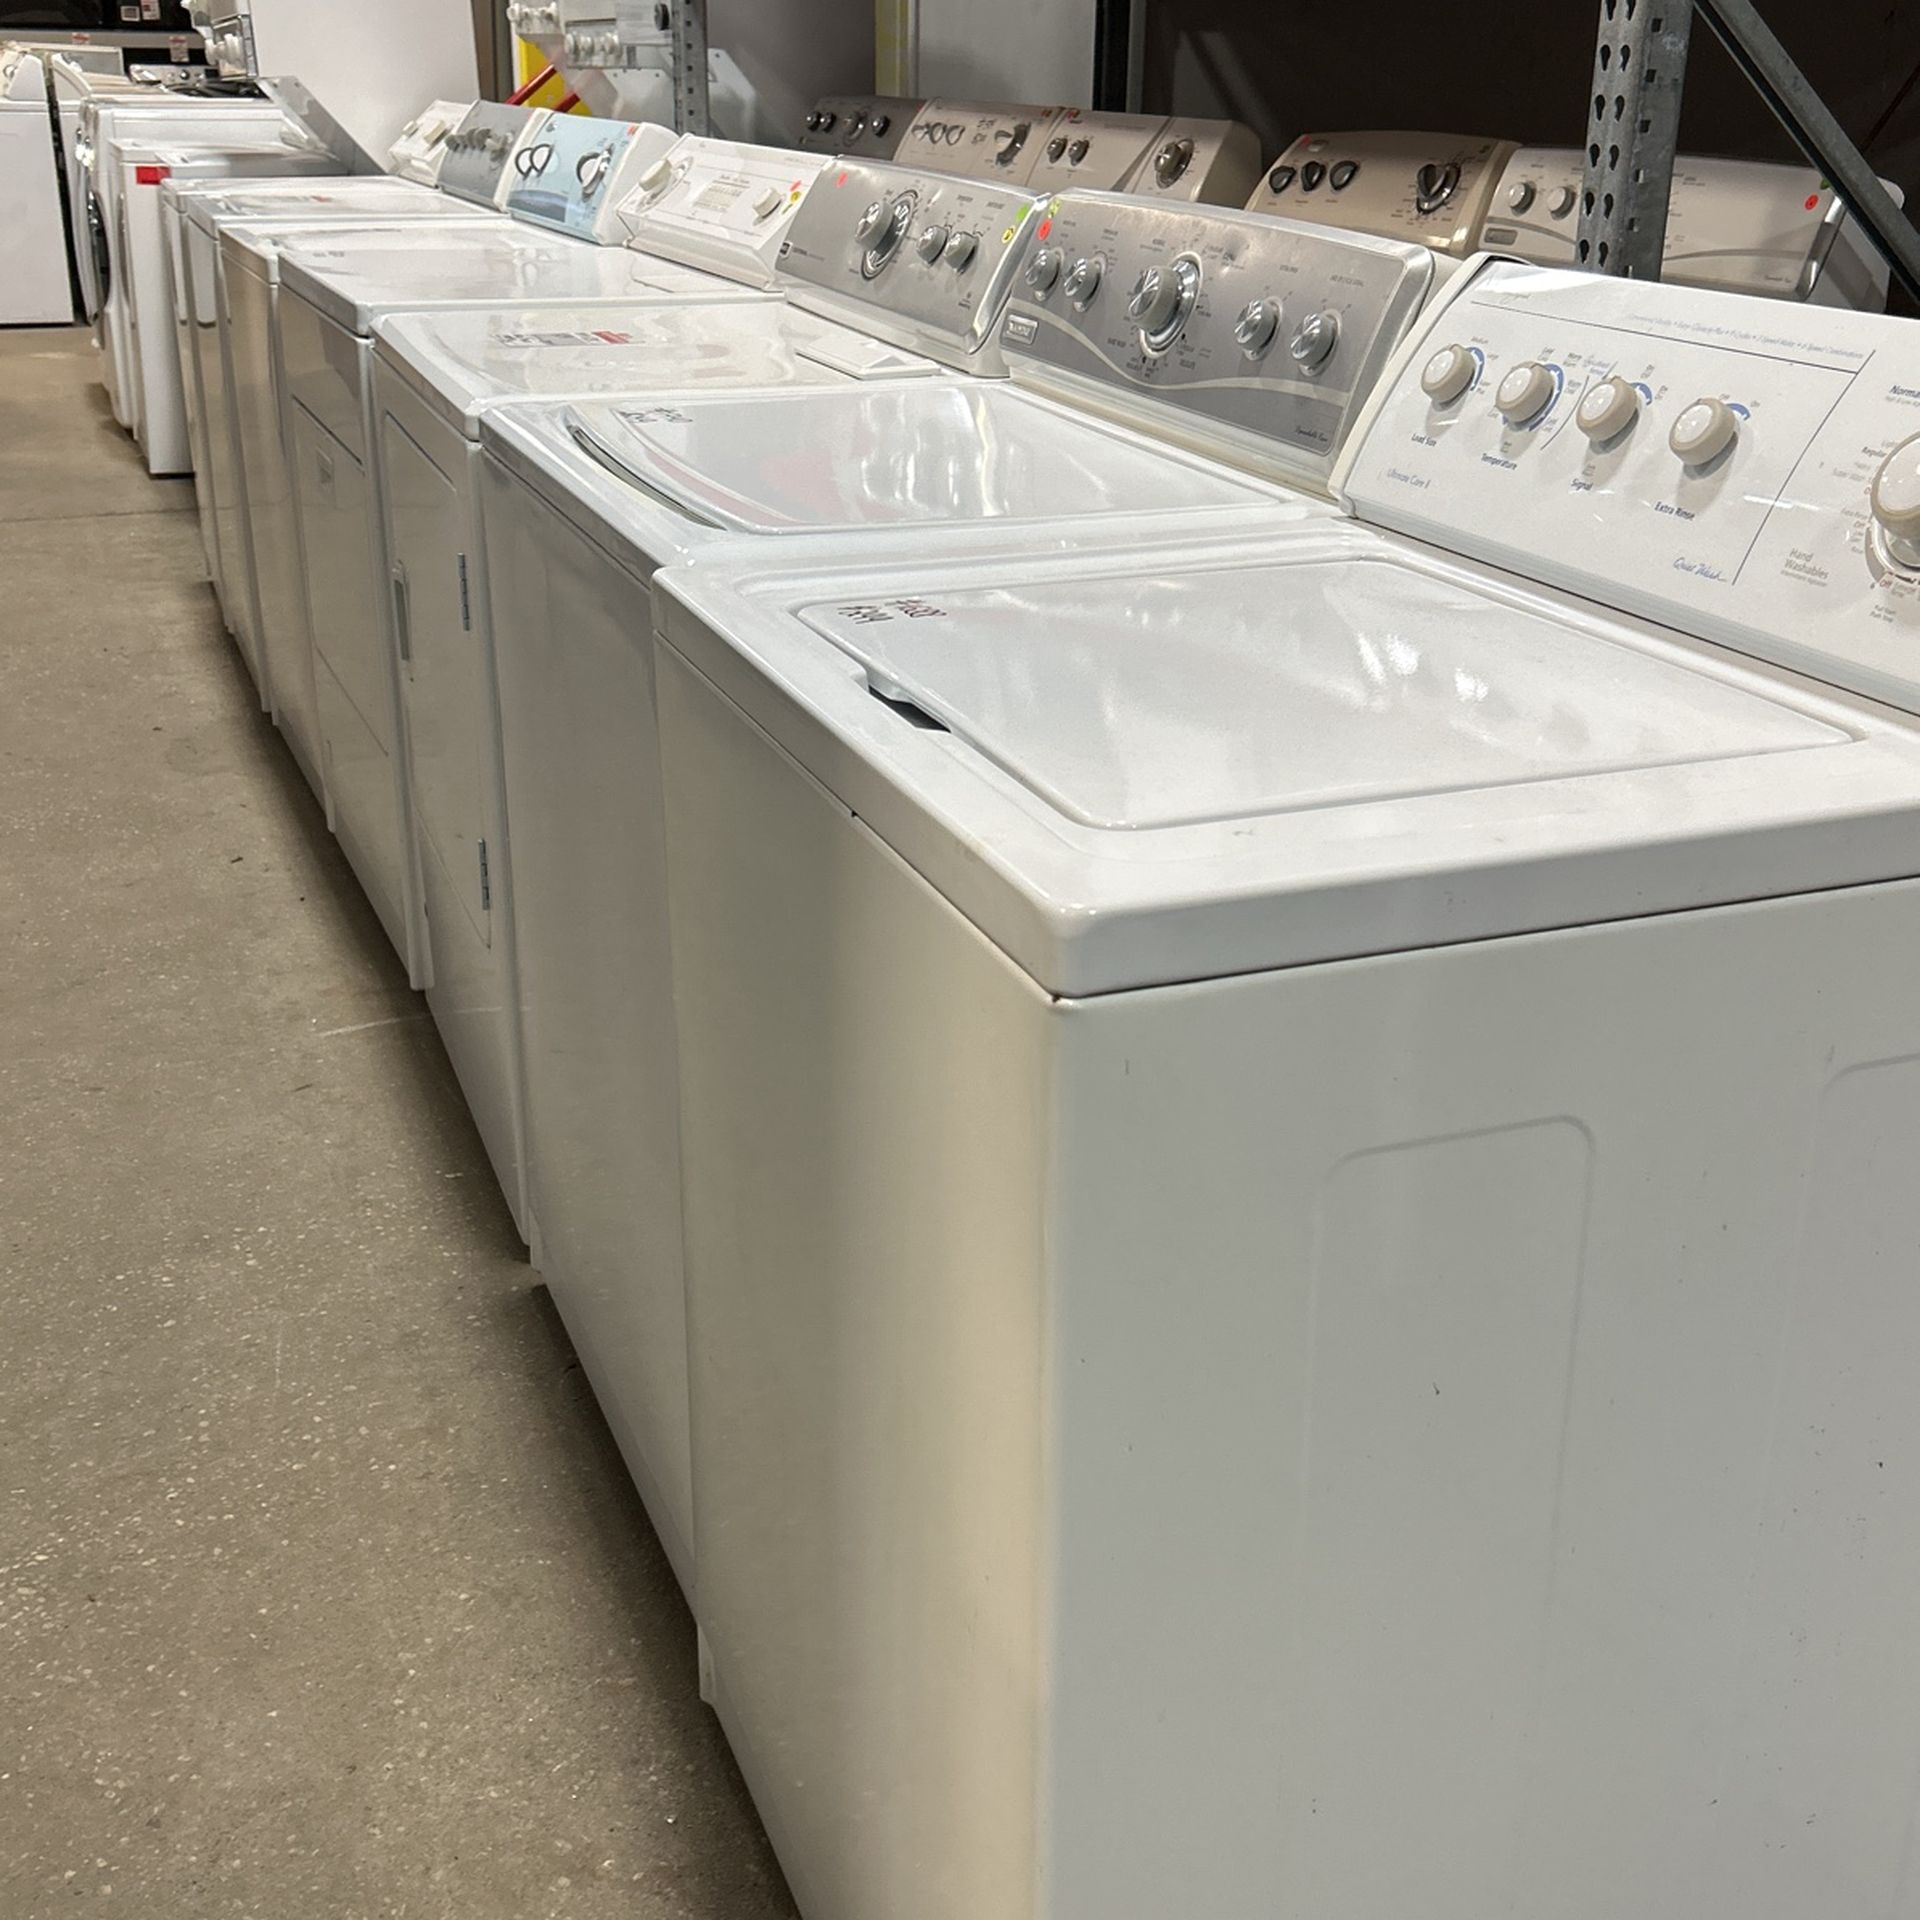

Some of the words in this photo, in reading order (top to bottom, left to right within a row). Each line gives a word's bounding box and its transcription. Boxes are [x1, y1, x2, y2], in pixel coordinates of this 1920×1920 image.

[1411, 432, 1427, 445] Load
[1424, 435, 1437, 447] Size
[1481, 452, 1518, 471] Temperature
[1571, 477, 1594, 492] Signal
[1654, 500, 1675, 515] Extra
[1675, 506, 1696, 521] Rinse
[1789, 547, 1815, 563] Hand
[1784, 558, 1830, 580] Washables
